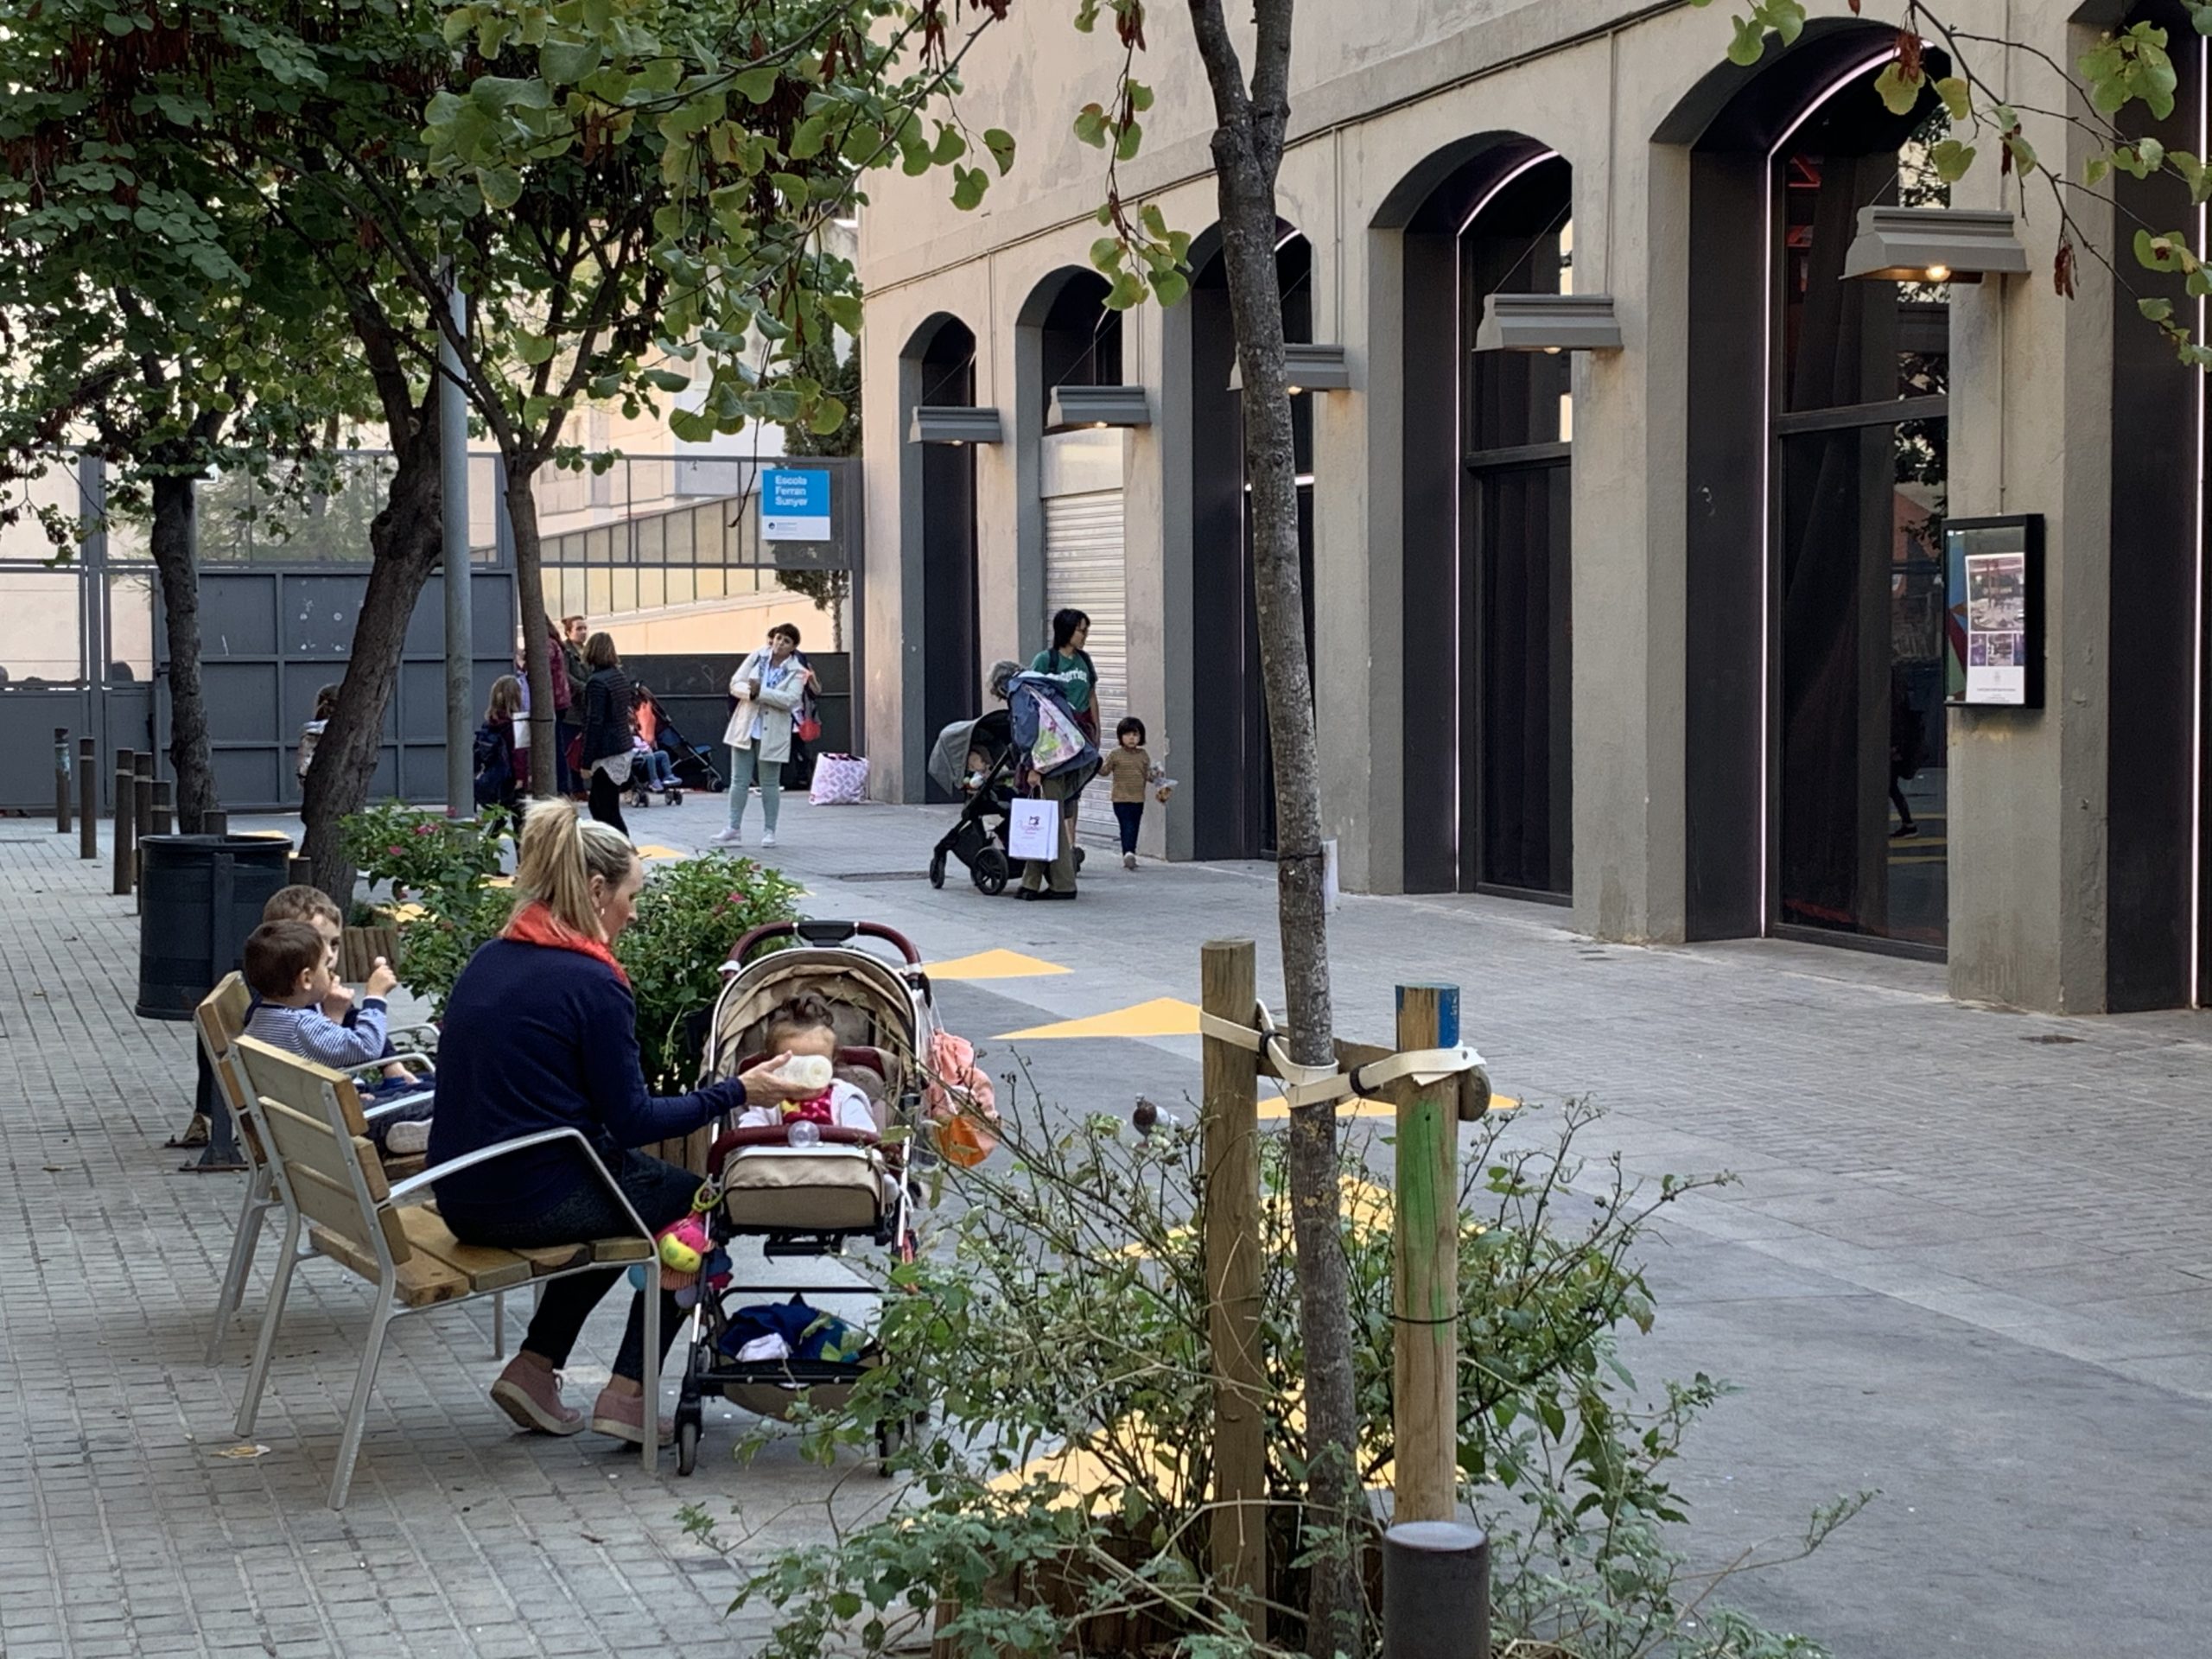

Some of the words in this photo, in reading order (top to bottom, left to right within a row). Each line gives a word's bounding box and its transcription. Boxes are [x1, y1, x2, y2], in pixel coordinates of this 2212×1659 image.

[774, 475, 808, 486] Escola
[774, 486, 807, 496] Ferran
[774, 496, 809, 508] Sunyer
